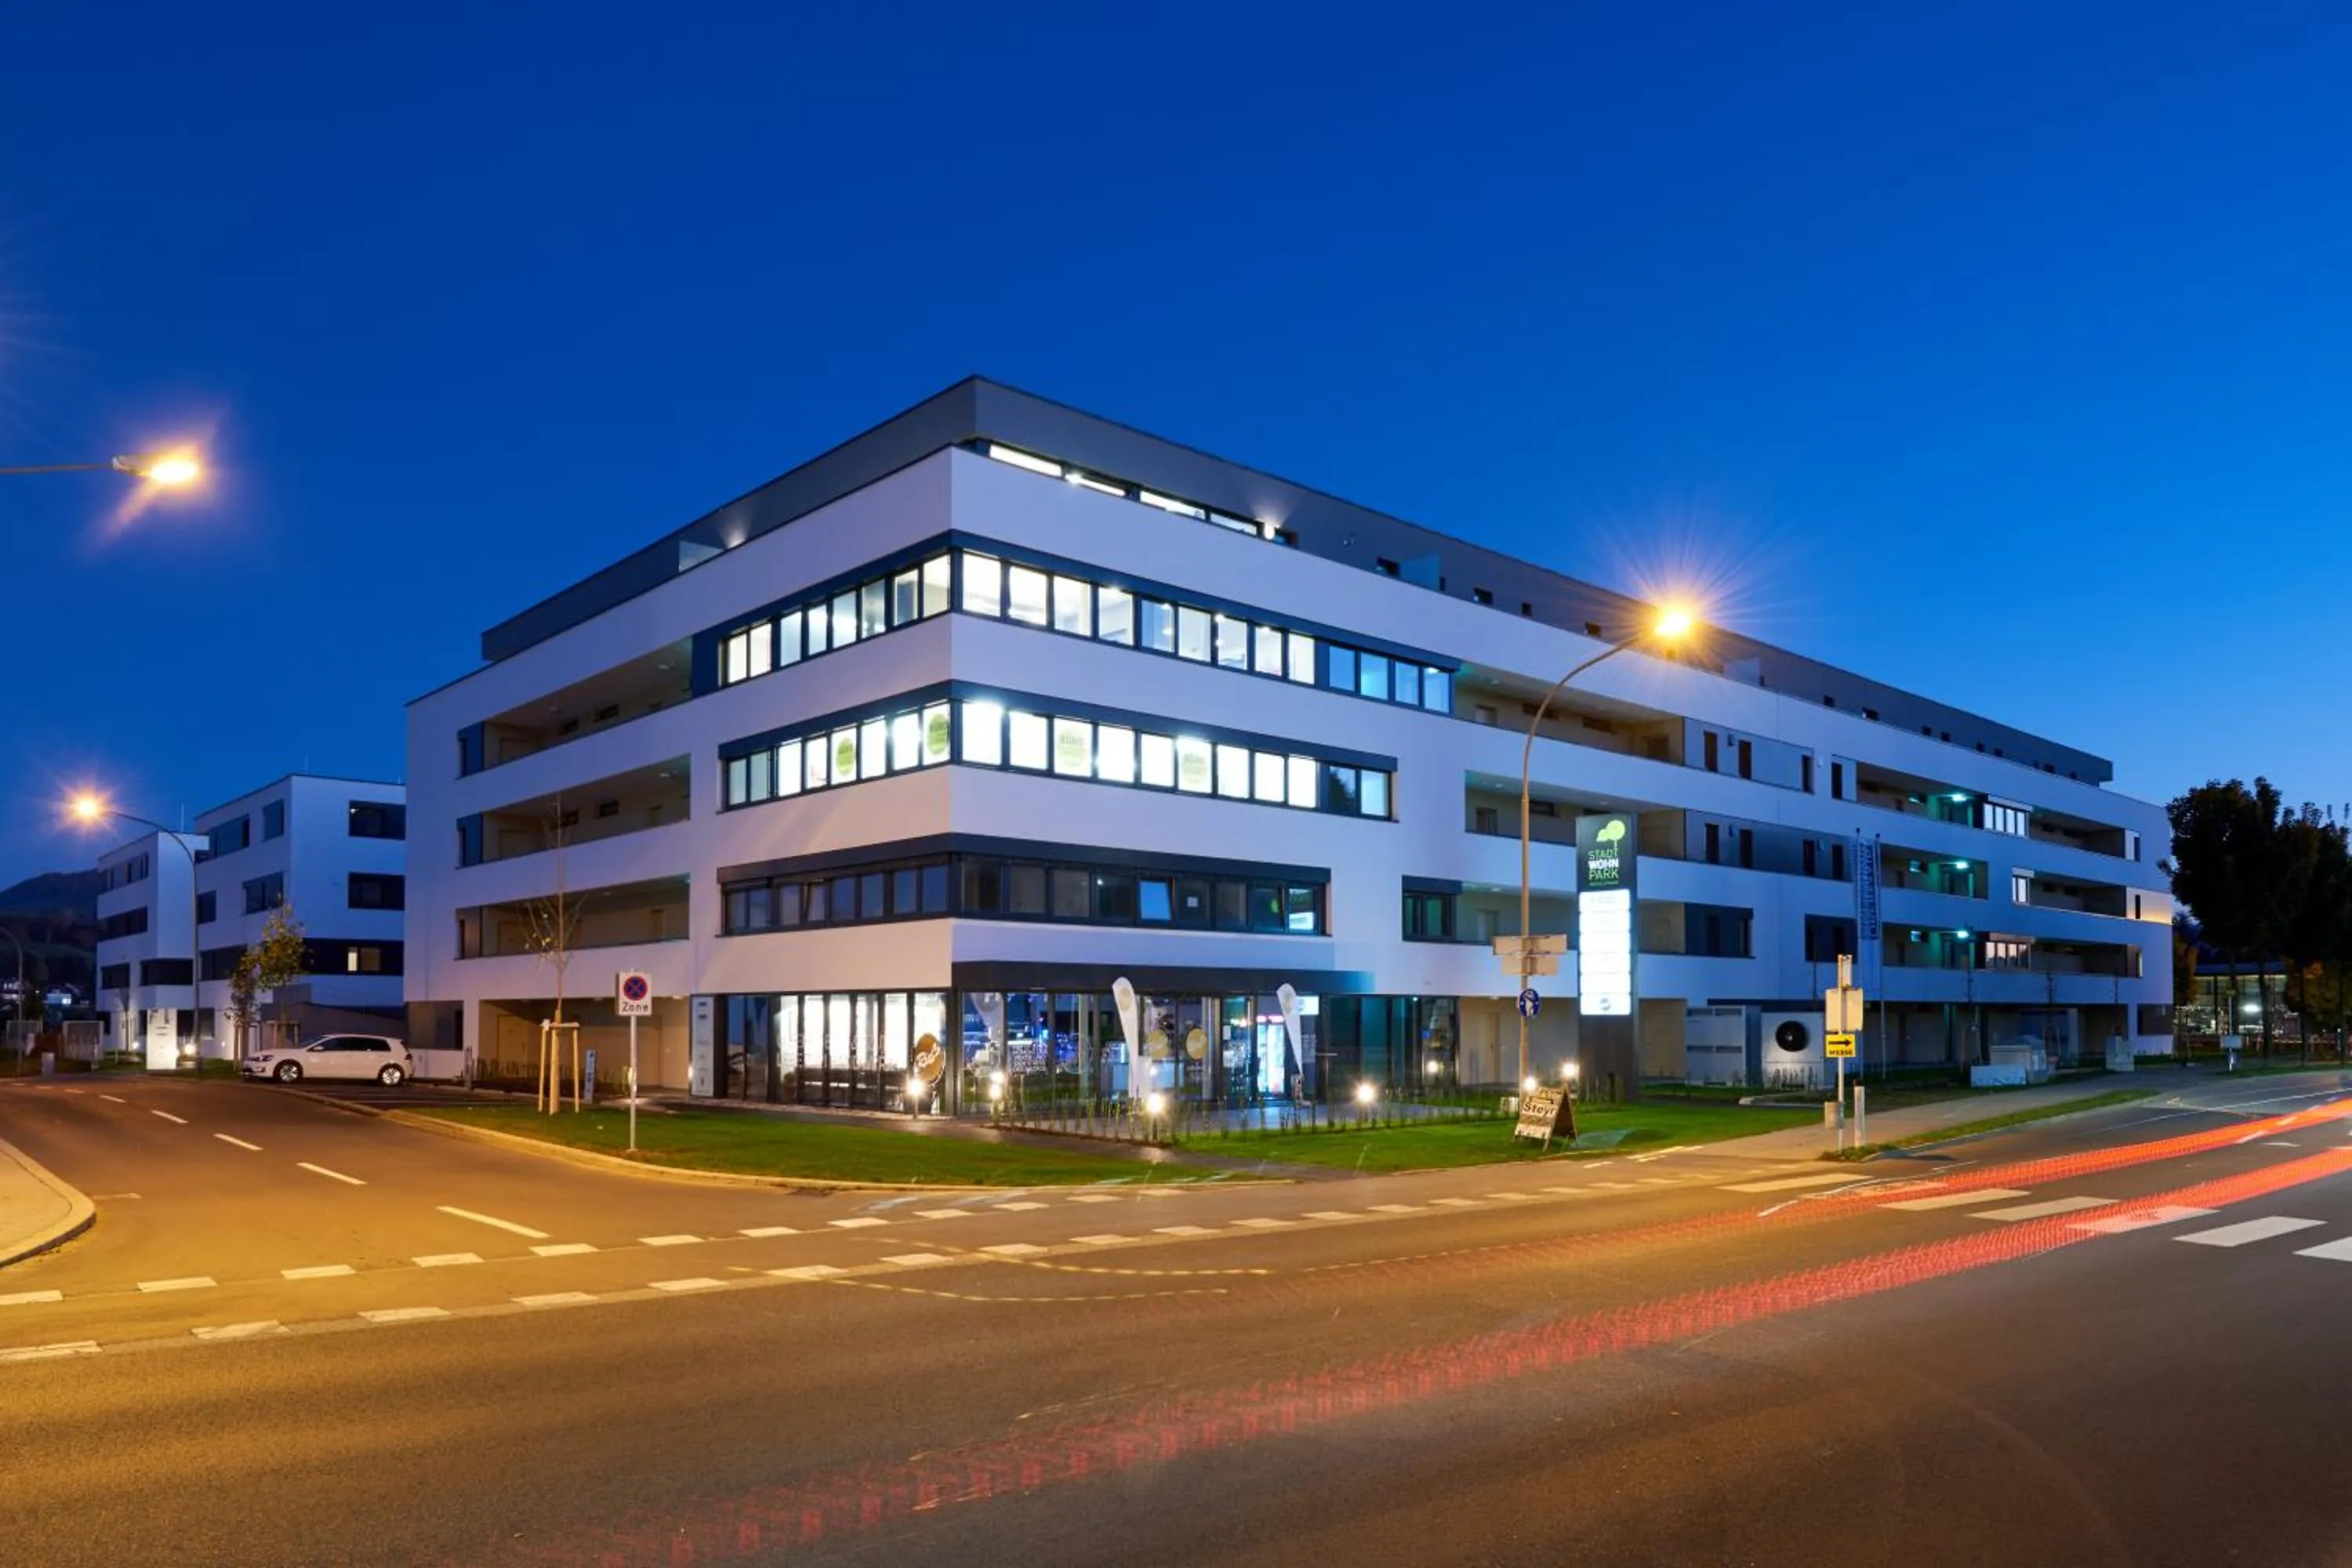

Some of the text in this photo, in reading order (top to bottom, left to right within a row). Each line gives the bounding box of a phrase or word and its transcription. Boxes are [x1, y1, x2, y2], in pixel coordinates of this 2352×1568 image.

[1588, 848, 1619, 860] STADT
[1588, 858, 1619, 869] WOHN
[1588, 868, 1619, 880] PARK
[622, 1002, 648, 1012] Zone
[1523, 1102, 1556, 1117] Steyr
